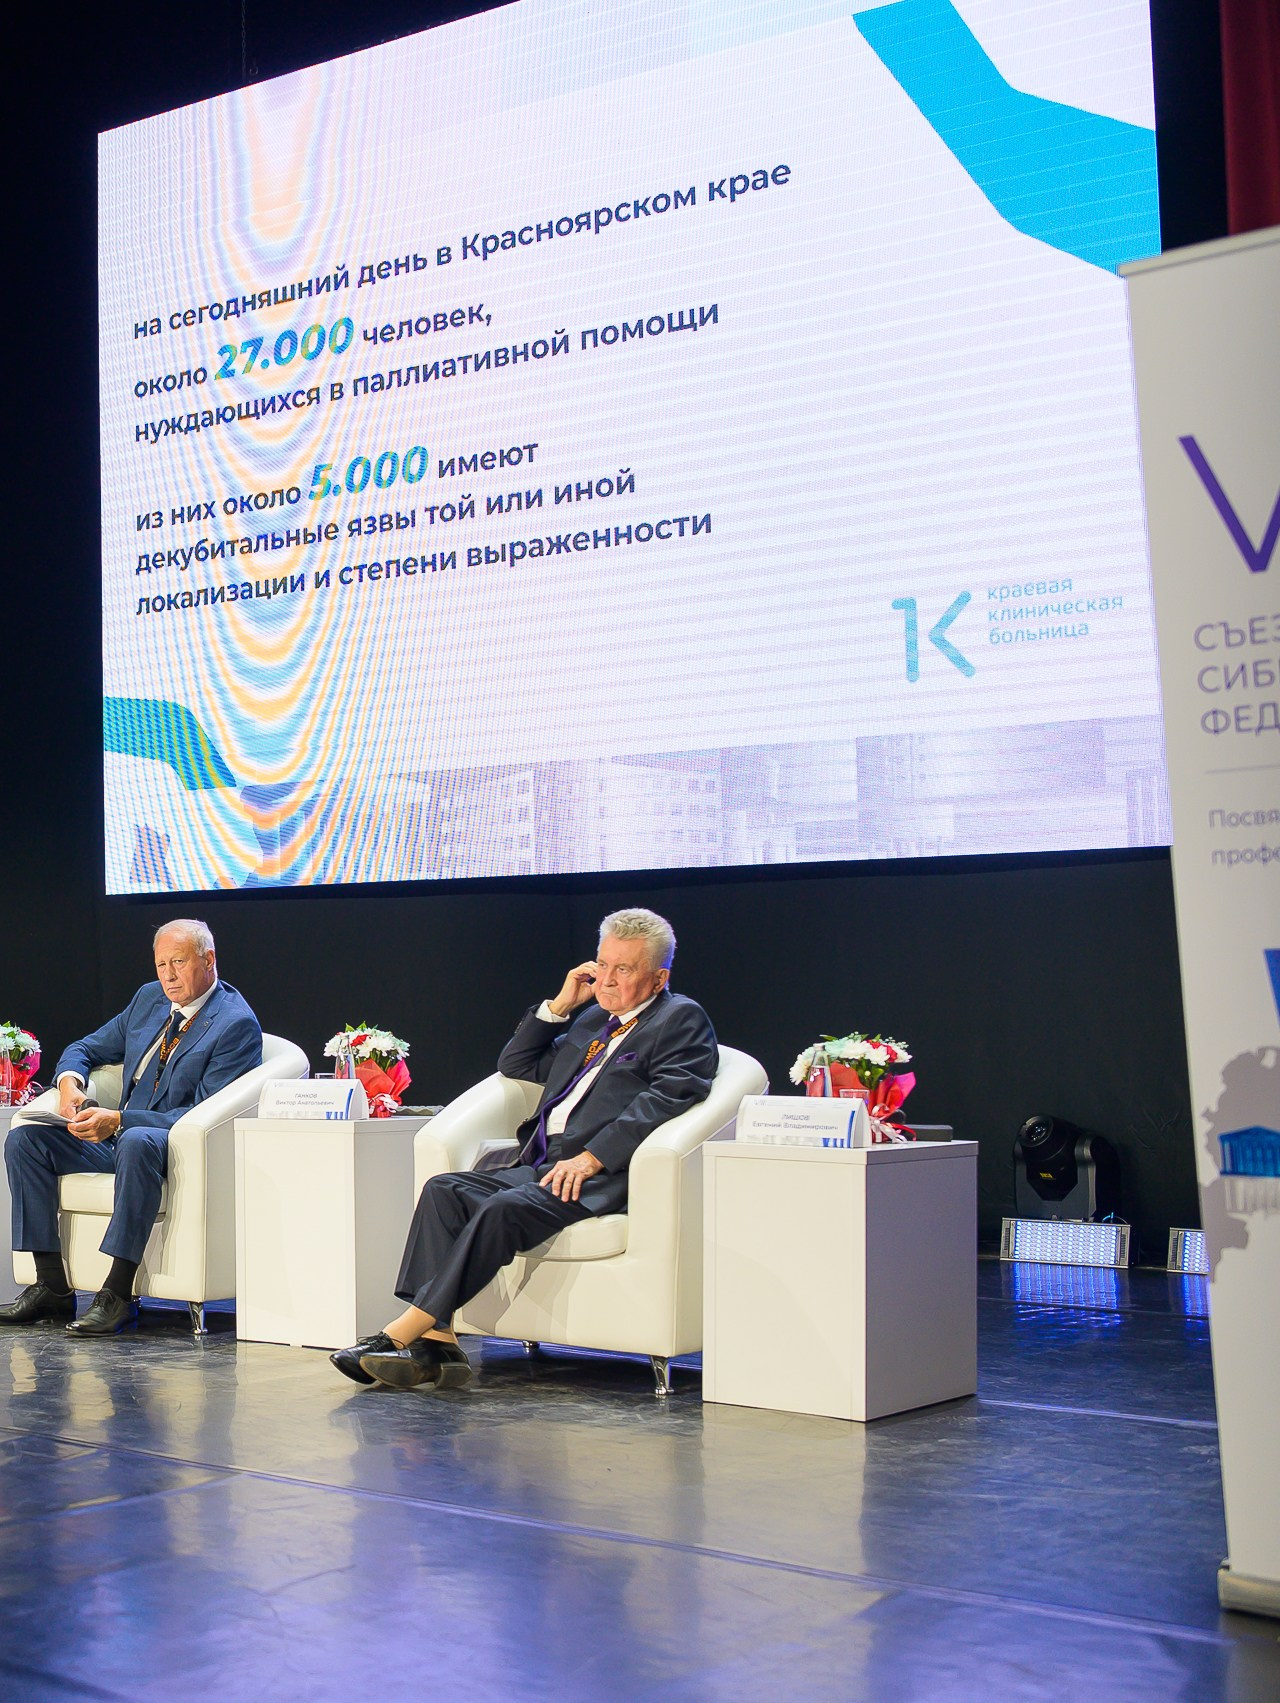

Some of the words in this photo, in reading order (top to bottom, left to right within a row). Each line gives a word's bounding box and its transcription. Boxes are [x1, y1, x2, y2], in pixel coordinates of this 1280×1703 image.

[134, 318, 161, 338] на
[169, 265, 350, 331] сегодняшний
[357, 253, 428, 288] день
[436, 244, 451, 266] в
[461, 185, 695, 260] Красноярском
[707, 162, 791, 203] крае
[134, 366, 208, 399] около
[213, 317, 354, 381] 27.000
[363, 302, 493, 347] человек,
[134, 385, 321, 444] нуждающихся
[330, 380, 344, 402] в
[353, 329, 569, 397] паллиативной
[581, 304, 720, 351] помощи
[135, 520, 339, 575] декубитальные
[347, 510, 417, 538] язвы
[425, 493, 476, 526] той
[486, 488, 543, 514] или
[554, 469, 636, 504] иной
[136, 509, 162, 532] из
[171, 499, 217, 528] них
[223, 484, 301, 517] около
[308, 445, 429, 502] 5.000
[437, 442, 538, 477] имеют
[136, 571, 305, 615] локализации
[314, 568, 330, 589] и
[339, 549, 457, 585] степени
[466, 512, 712, 568] выраженности
[988, 579, 1073, 602] краевая
[988, 595, 1123, 622] клиническая
[989, 621, 1089, 645] больница
[1198, 659, 1280, 693] СИБ
